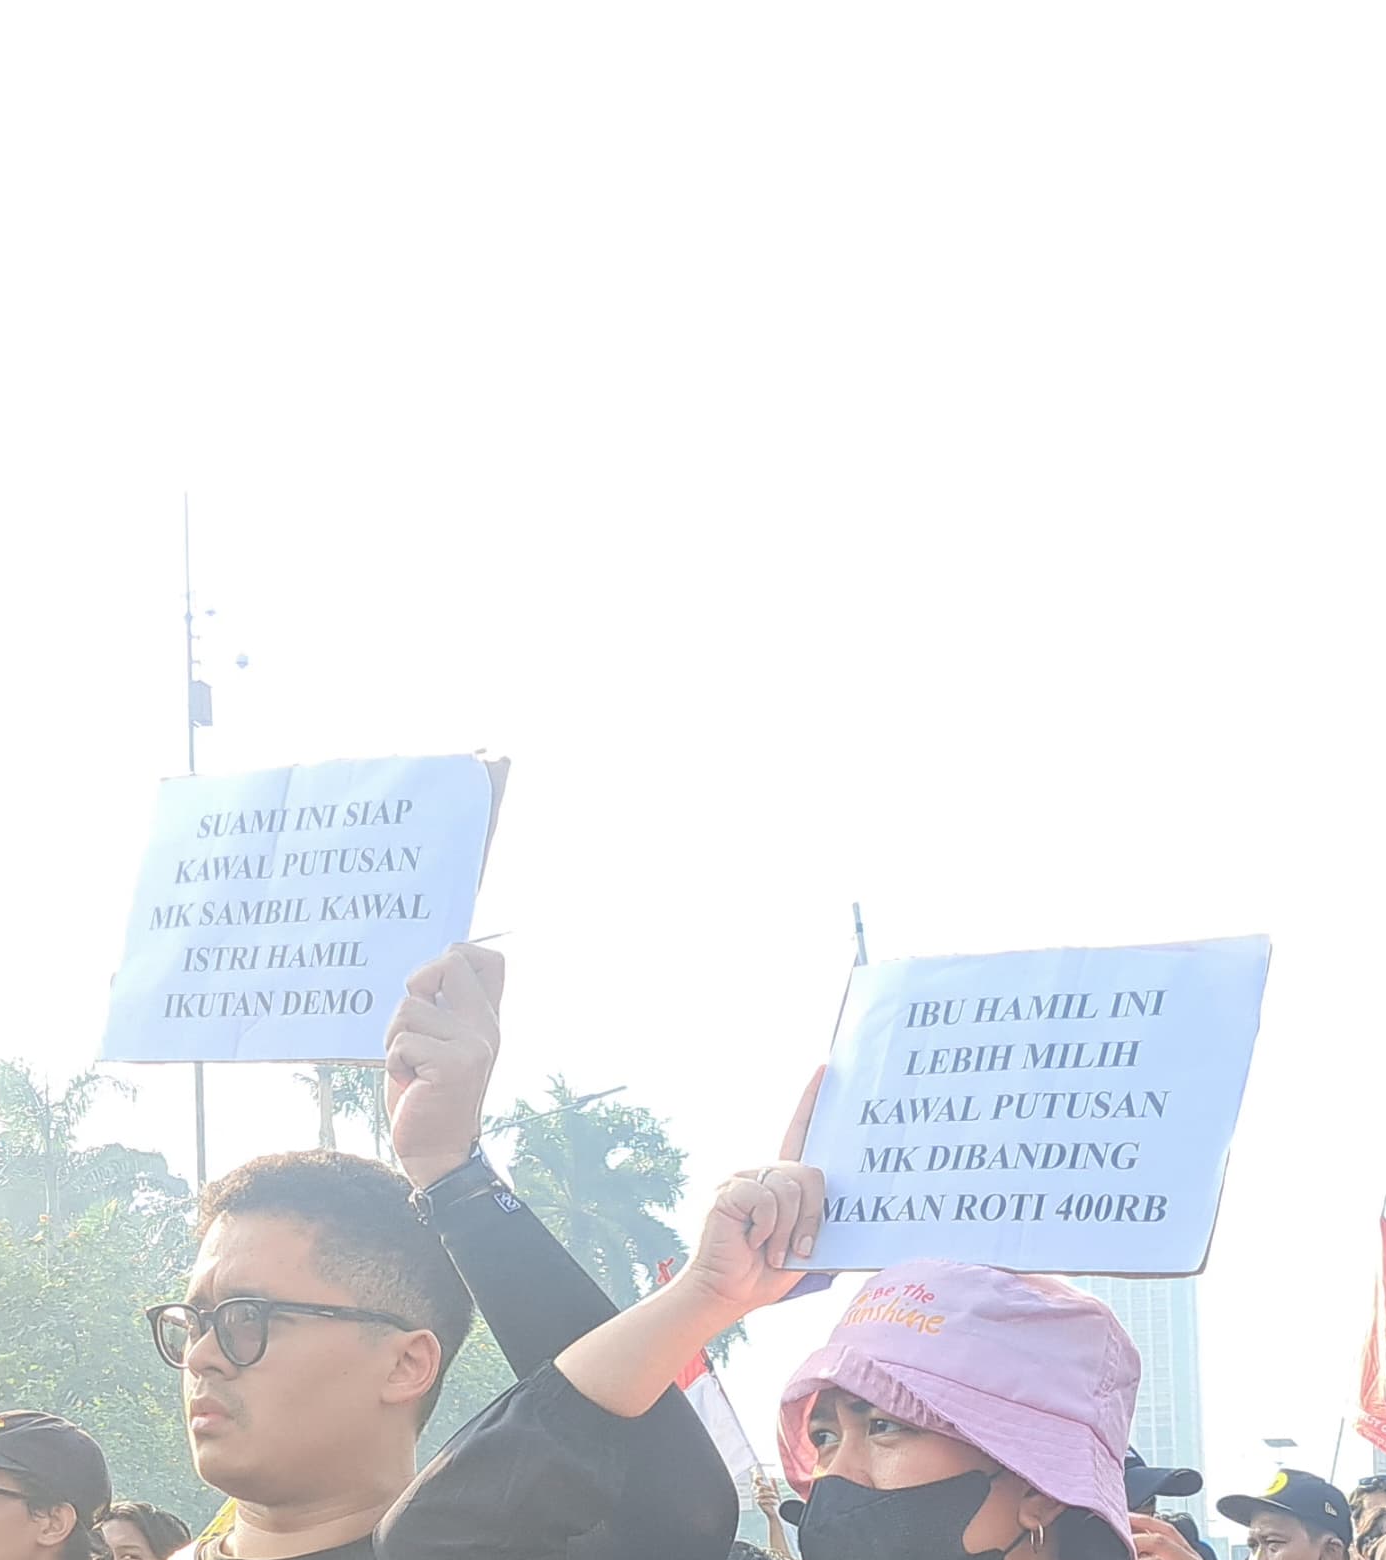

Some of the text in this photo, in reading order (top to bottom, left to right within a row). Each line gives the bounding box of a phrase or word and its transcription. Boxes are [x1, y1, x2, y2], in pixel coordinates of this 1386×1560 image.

[197, 799, 413, 839] SUAMI INI SIAP
[175, 846, 421, 884] KAWAL PUTUSAN
[149, 893, 431, 930] MK SAMBIL KAWAL
[182, 941, 368, 972] ISTRI HAMIL
[164, 988, 374, 1019] IKUTAN DEMO
[905, 989, 1168, 1029] IBU HAMIL INI
[904, 1040, 1142, 1076] LEBIH MILIH
[858, 1090, 1170, 1126] KAWAL PUTUSAN
[858, 1142, 1140, 1173] MK DIBANDING
[952, 1193, 1048, 1223] ROTI
[1055, 1194, 1168, 1223] 400RB
